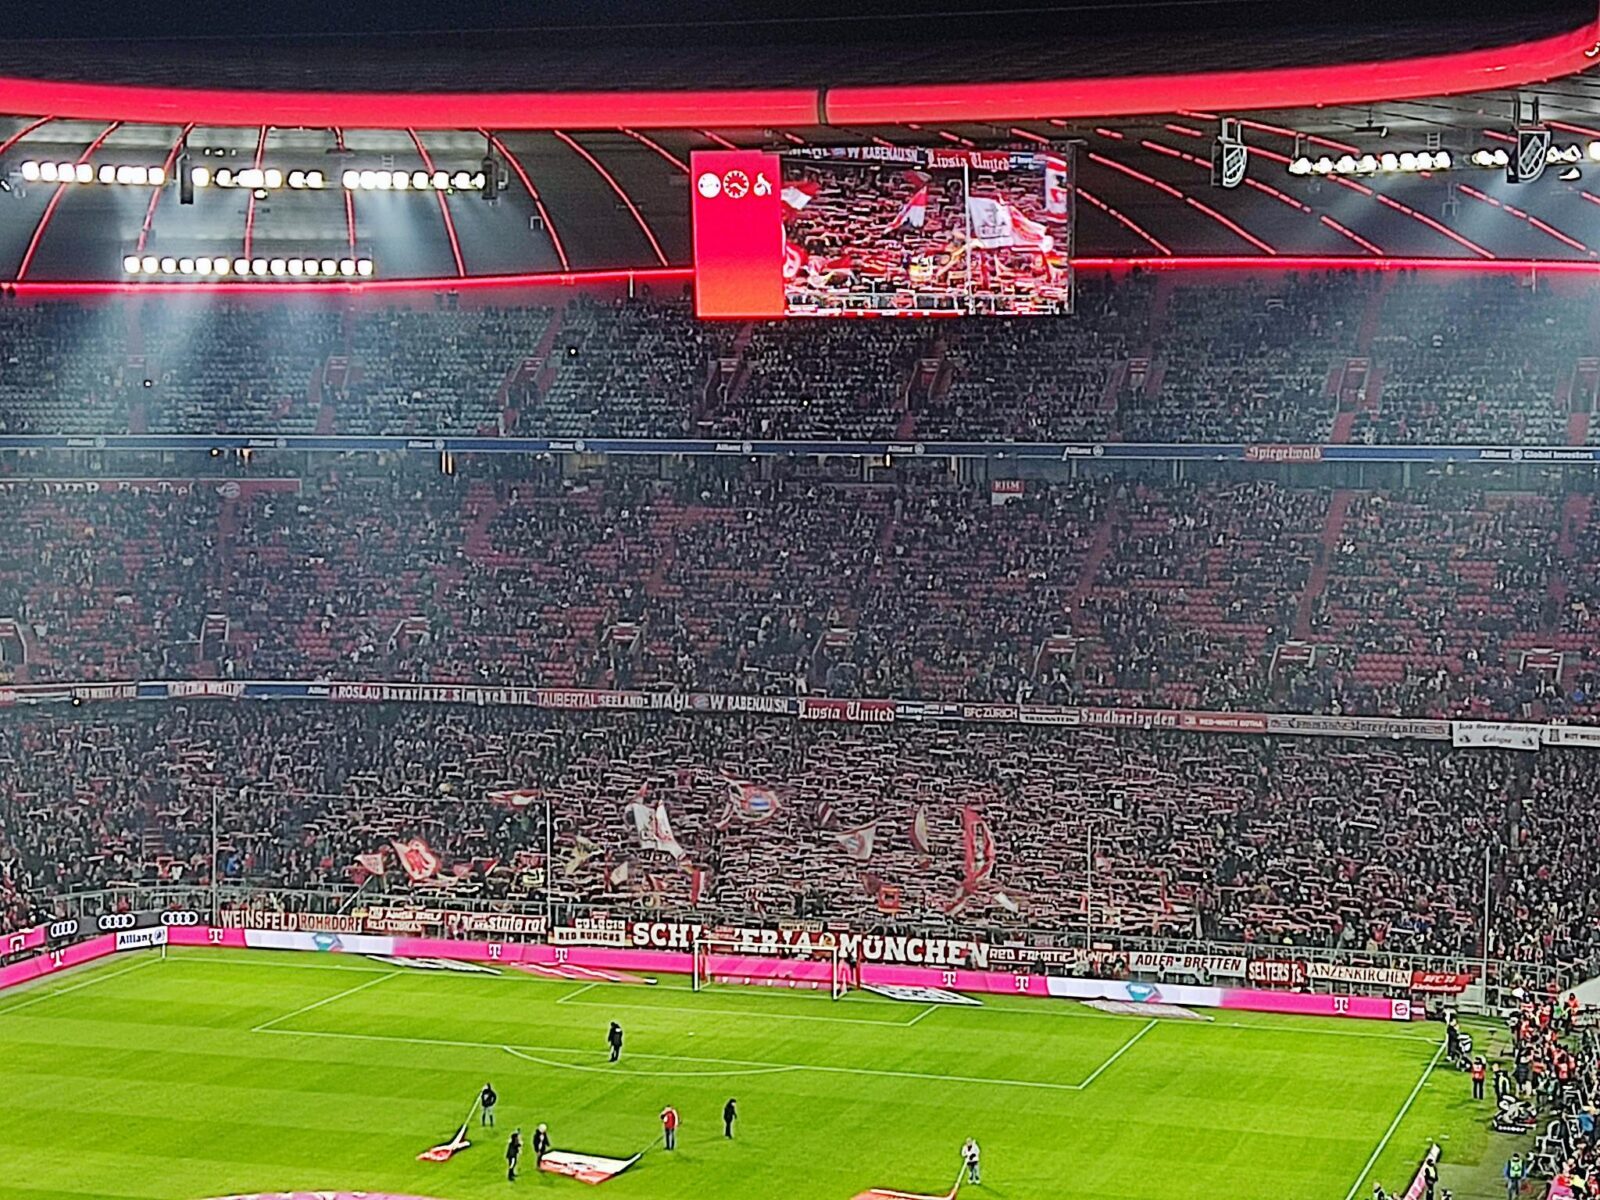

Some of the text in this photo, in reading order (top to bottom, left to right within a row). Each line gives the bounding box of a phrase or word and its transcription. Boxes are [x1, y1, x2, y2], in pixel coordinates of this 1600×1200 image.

[716, 443, 741, 452] Allianz
[1246, 445, 1322, 461] Spiegelwald
[1480, 449, 1593, 461] Allianz Global Investors
[537, 692, 598, 708] TAUBERTAL
[600, 695, 643, 708] SEELAND
[844, 700, 896, 723] United
[1081, 708, 1176, 727] Sandharlanden
[220, 910, 298, 931] WEINSFELD
[300, 914, 363, 932] ROHRDORF
[838, 932, 989, 970] MÜNCHEN
[989, 949, 1015, 960] RED
[1135, 954, 1242, 971] ADLER BRETTEN
[1248, 961, 1290, 982] SELTERS
[1310, 963, 1410, 984] ANZENKIRCHEN
